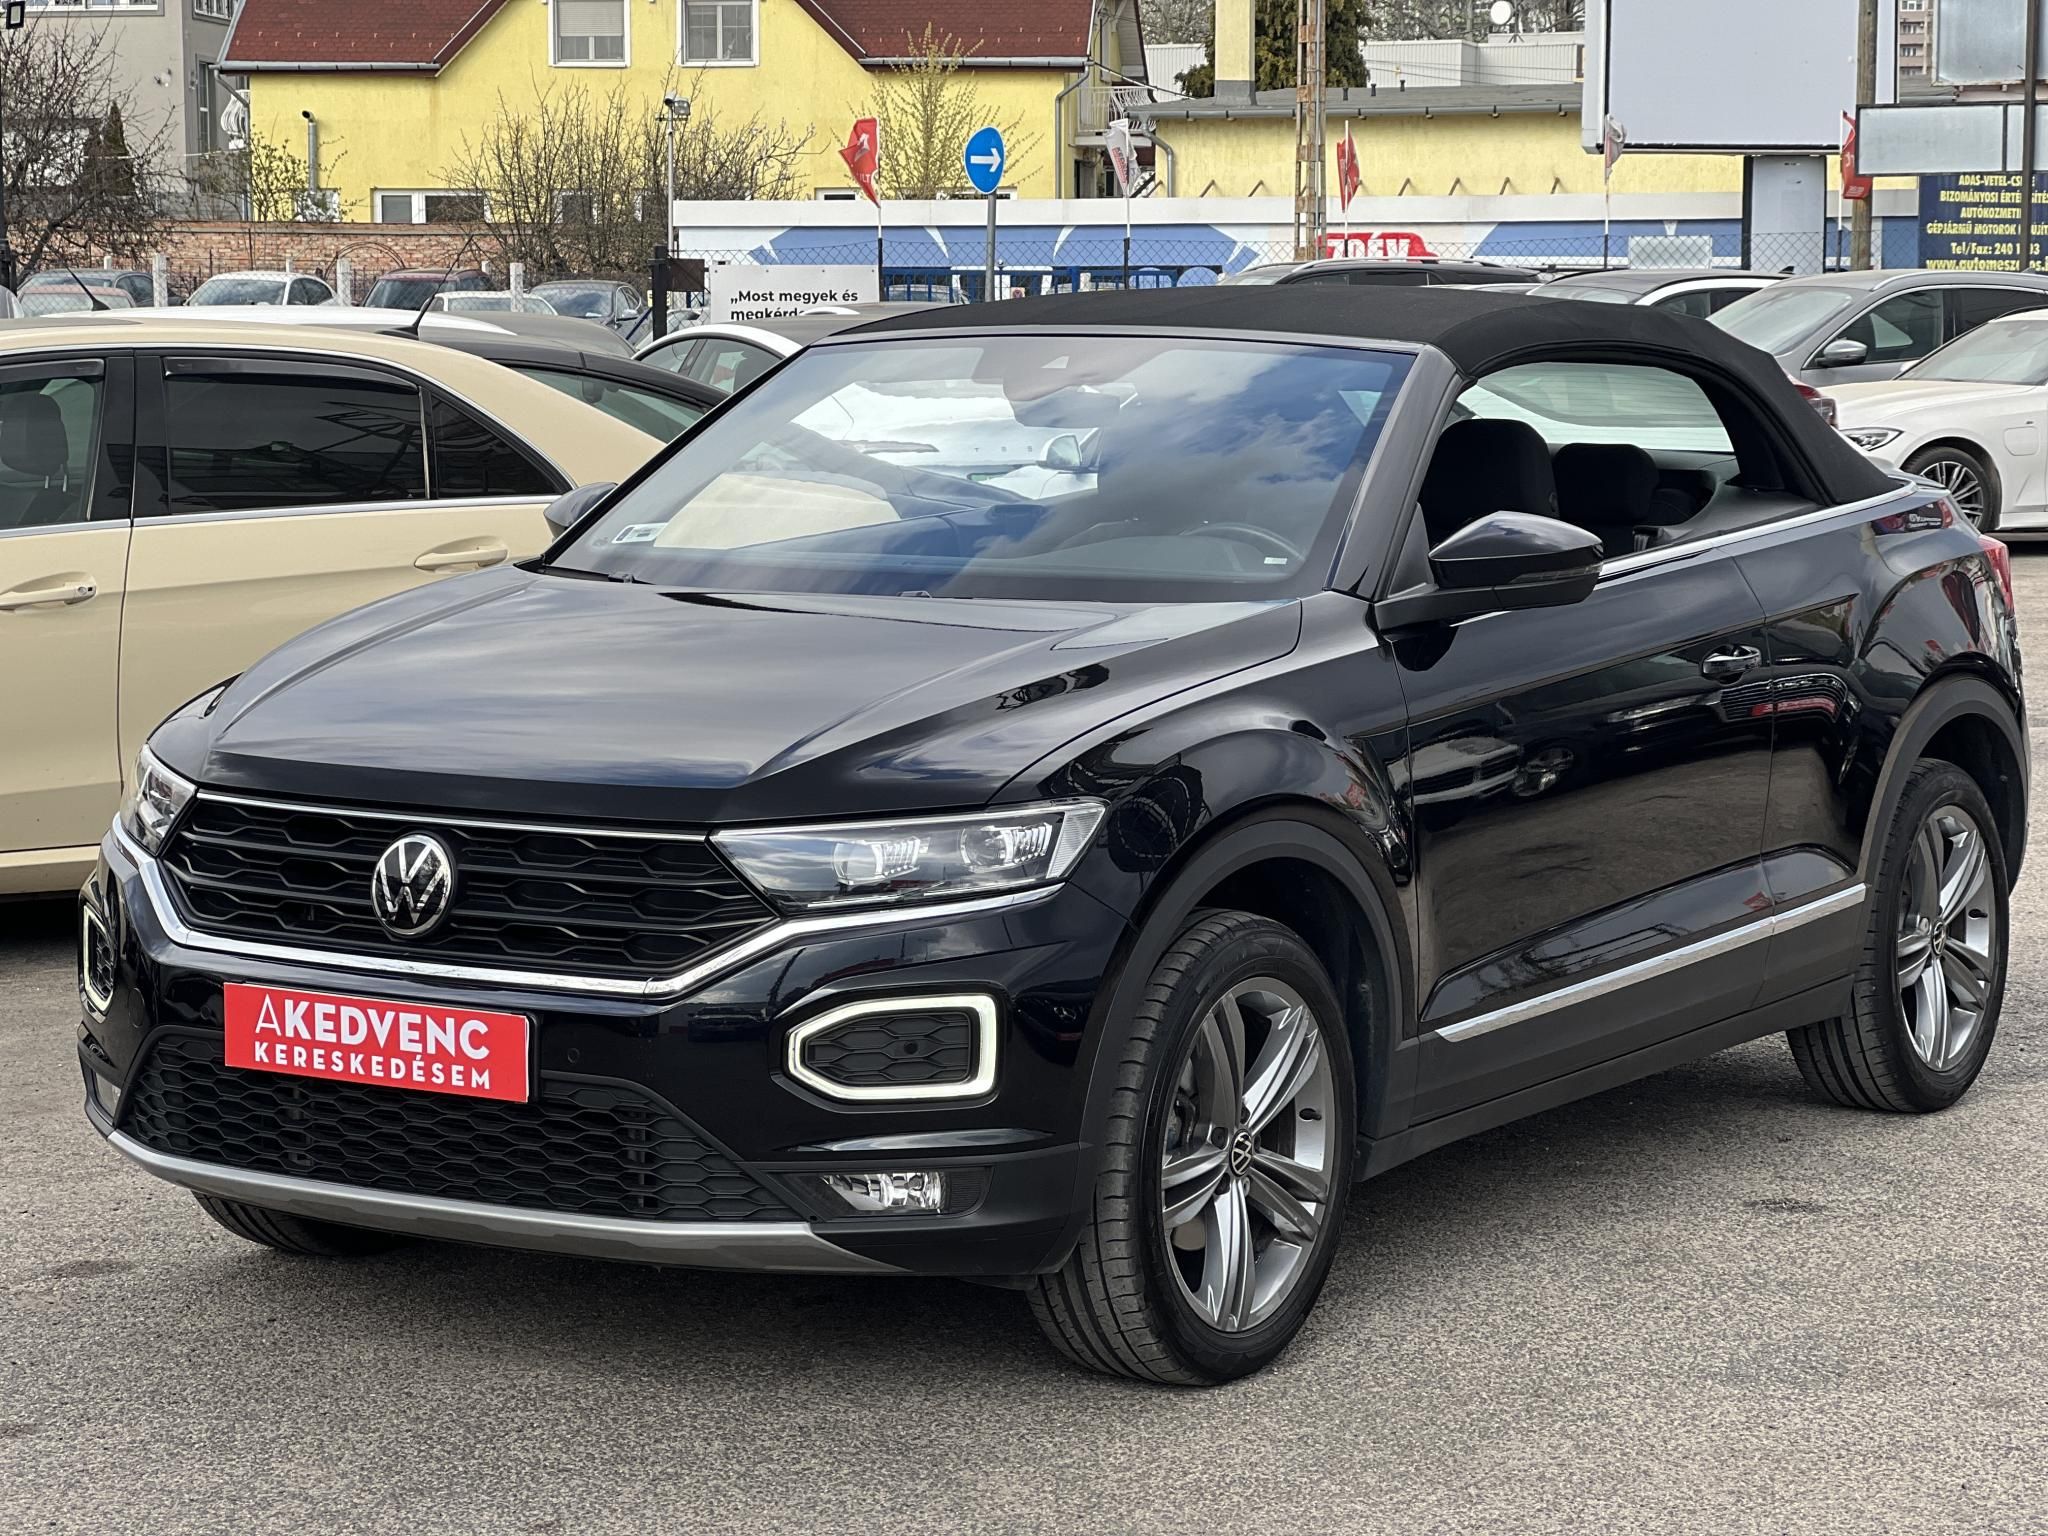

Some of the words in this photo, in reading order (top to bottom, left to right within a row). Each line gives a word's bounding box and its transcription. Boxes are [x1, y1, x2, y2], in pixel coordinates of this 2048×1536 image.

[1940, 189, 1998, 203] BIZOMÁNYOSI
[2001, 189, 2048, 204] ÉRTÉÍTÉ
[1960, 205, 2022, 219] AUTÓKOZMETI
[1974, 223, 2016, 235] MOTOROK
[1951, 242, 1992, 255] Tel/Fax:
[1994, 242, 2013, 255] 240
[778, 289, 837, 305] megyek
[841, 289, 858, 302] és
[254, 1041, 490, 1090] KERESKEDÉSEM
